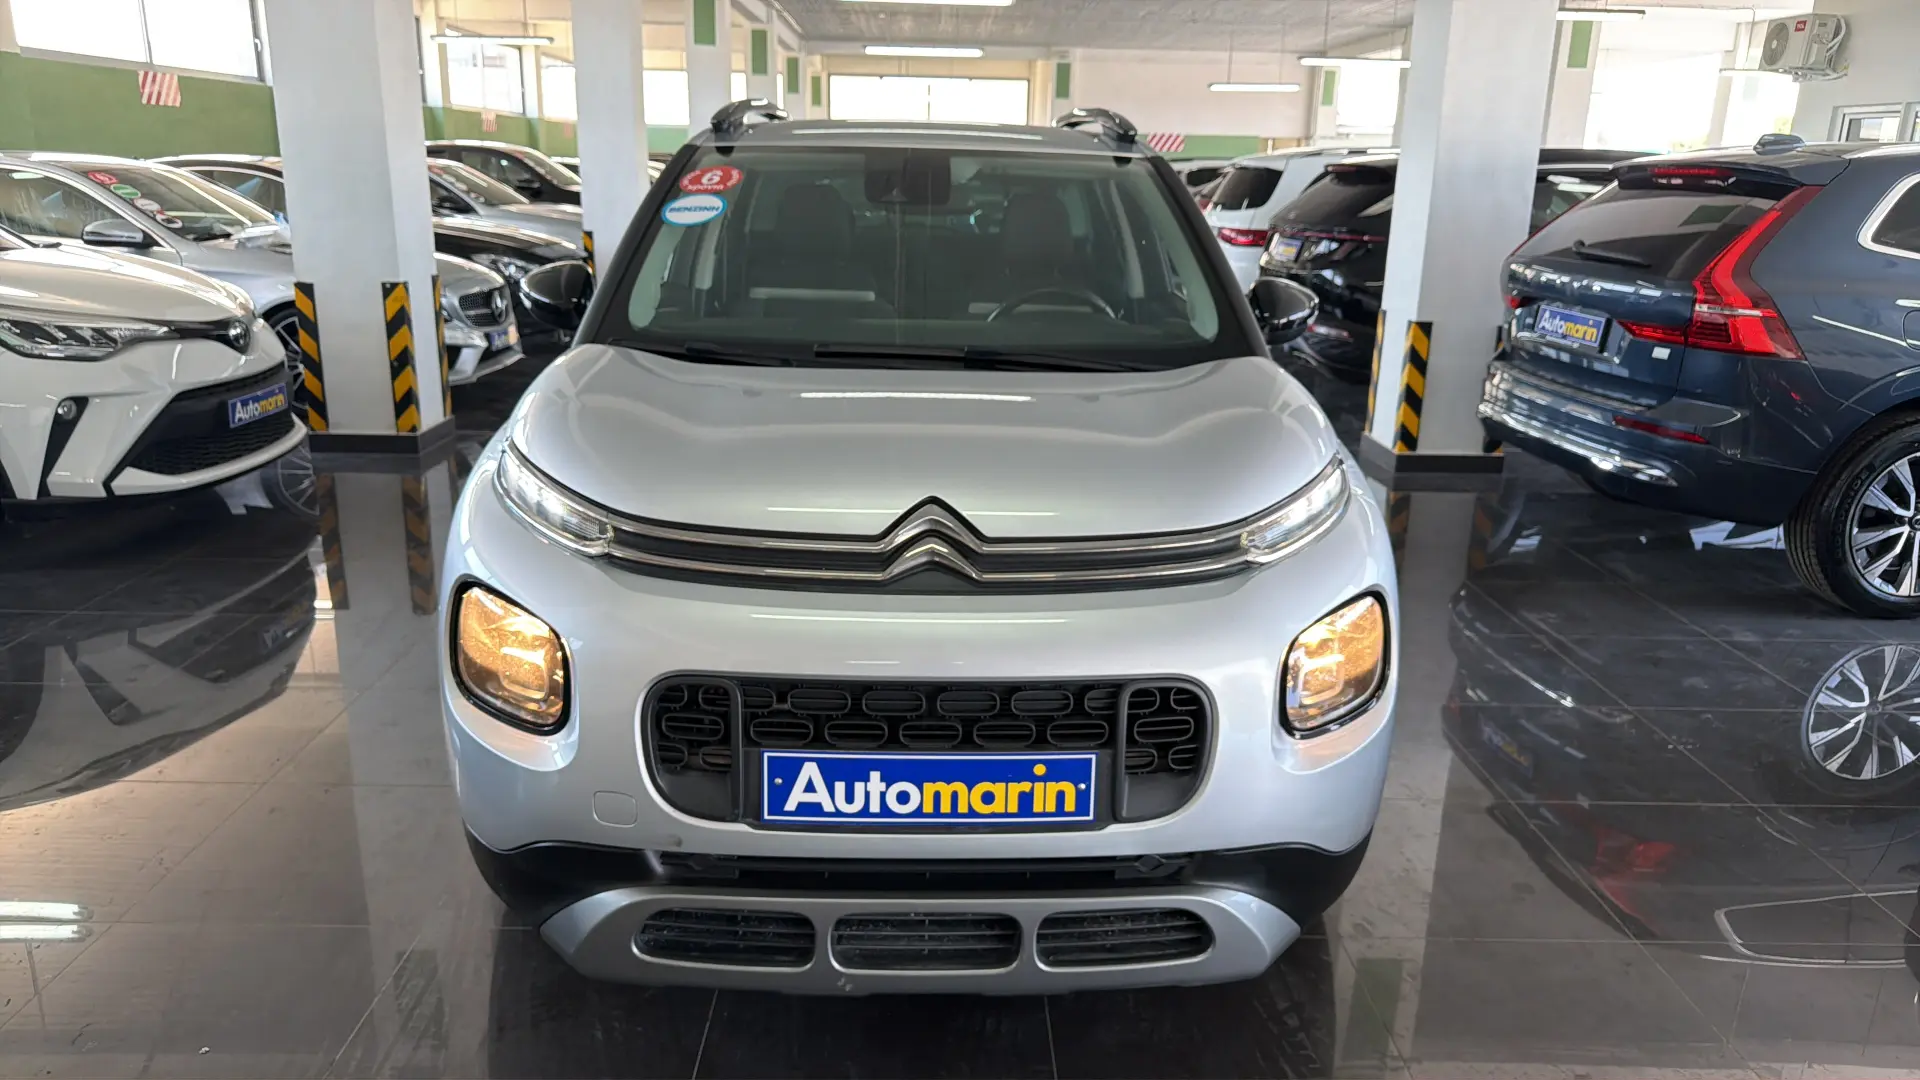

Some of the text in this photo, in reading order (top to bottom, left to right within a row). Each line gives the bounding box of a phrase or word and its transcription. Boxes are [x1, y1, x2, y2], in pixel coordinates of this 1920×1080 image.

[701, 169, 723, 186] 6
[1538, 309, 1598, 342] Automarin
[234, 389, 285, 424] Automarin
[783, 761, 1076, 814] Automarin
